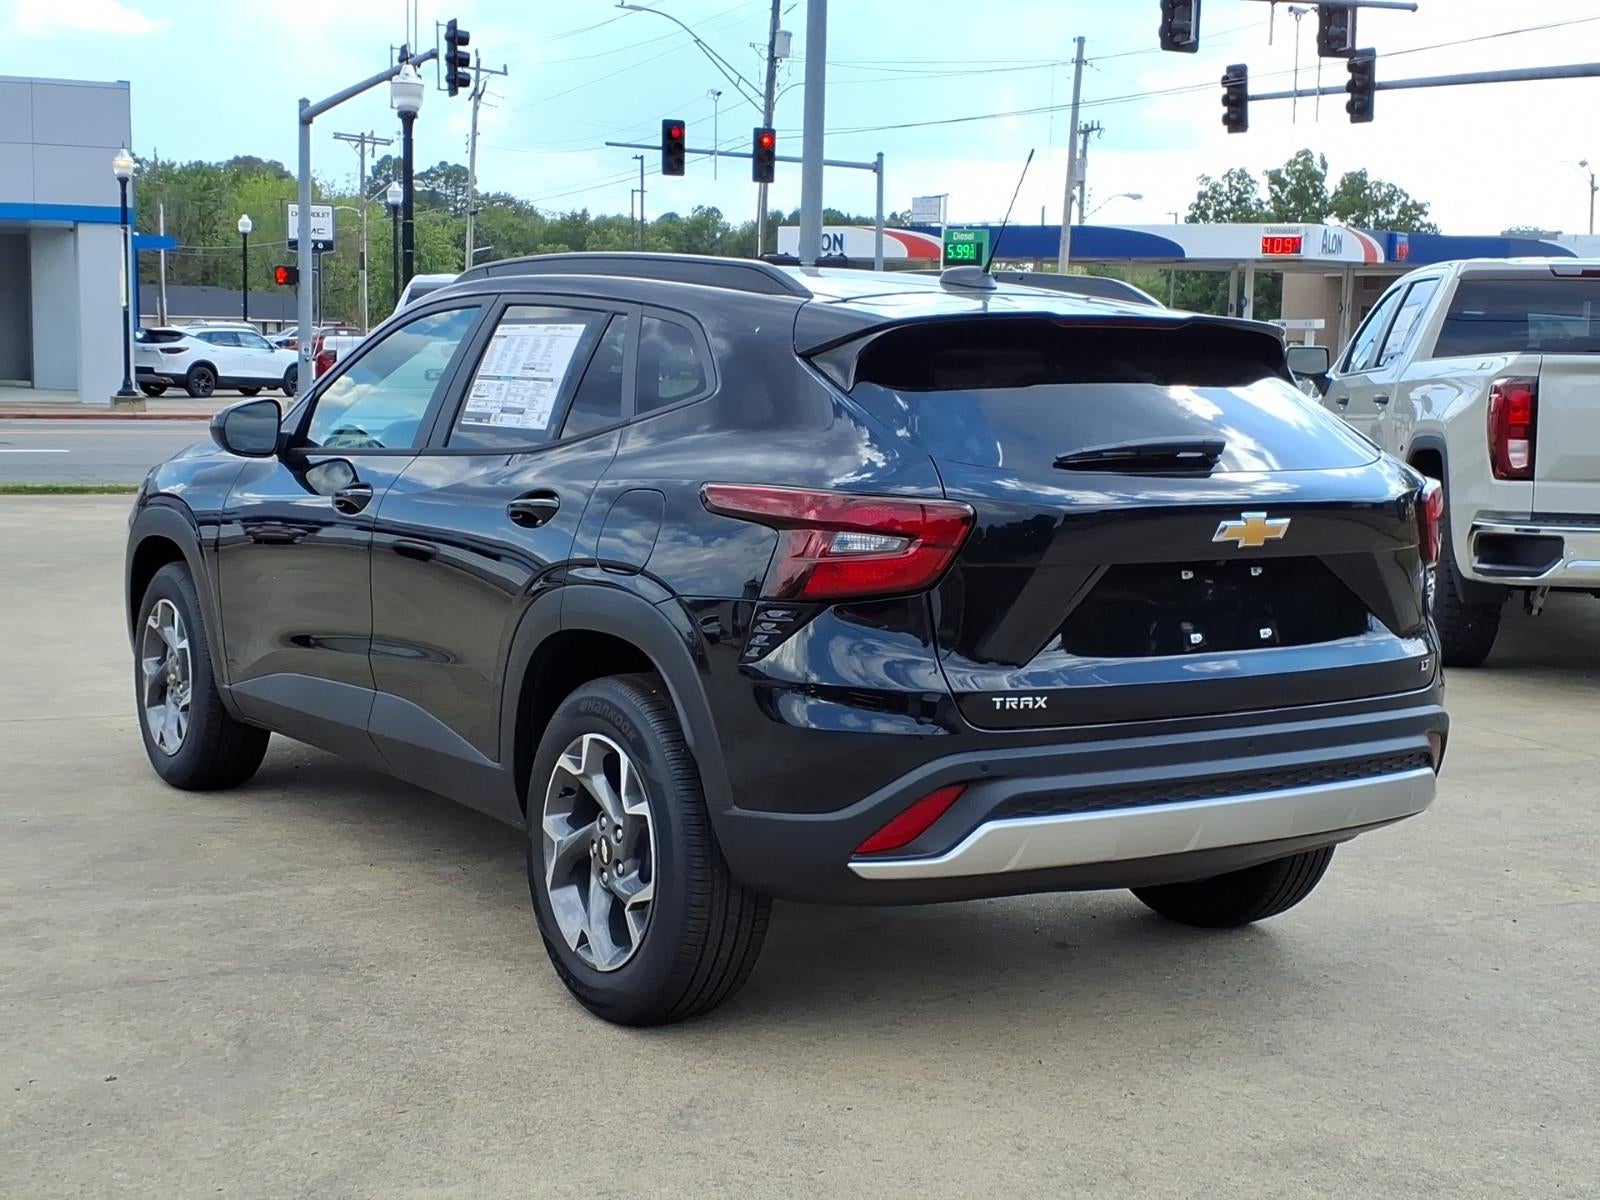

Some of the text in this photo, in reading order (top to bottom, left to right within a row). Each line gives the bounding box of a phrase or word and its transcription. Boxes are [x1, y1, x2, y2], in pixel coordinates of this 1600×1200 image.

[822, 233, 844, 251] ON
[952, 232, 974, 240] Diesel
[1321, 229, 1343, 254] ALON
[991, 696, 1048, 710] TRAX
